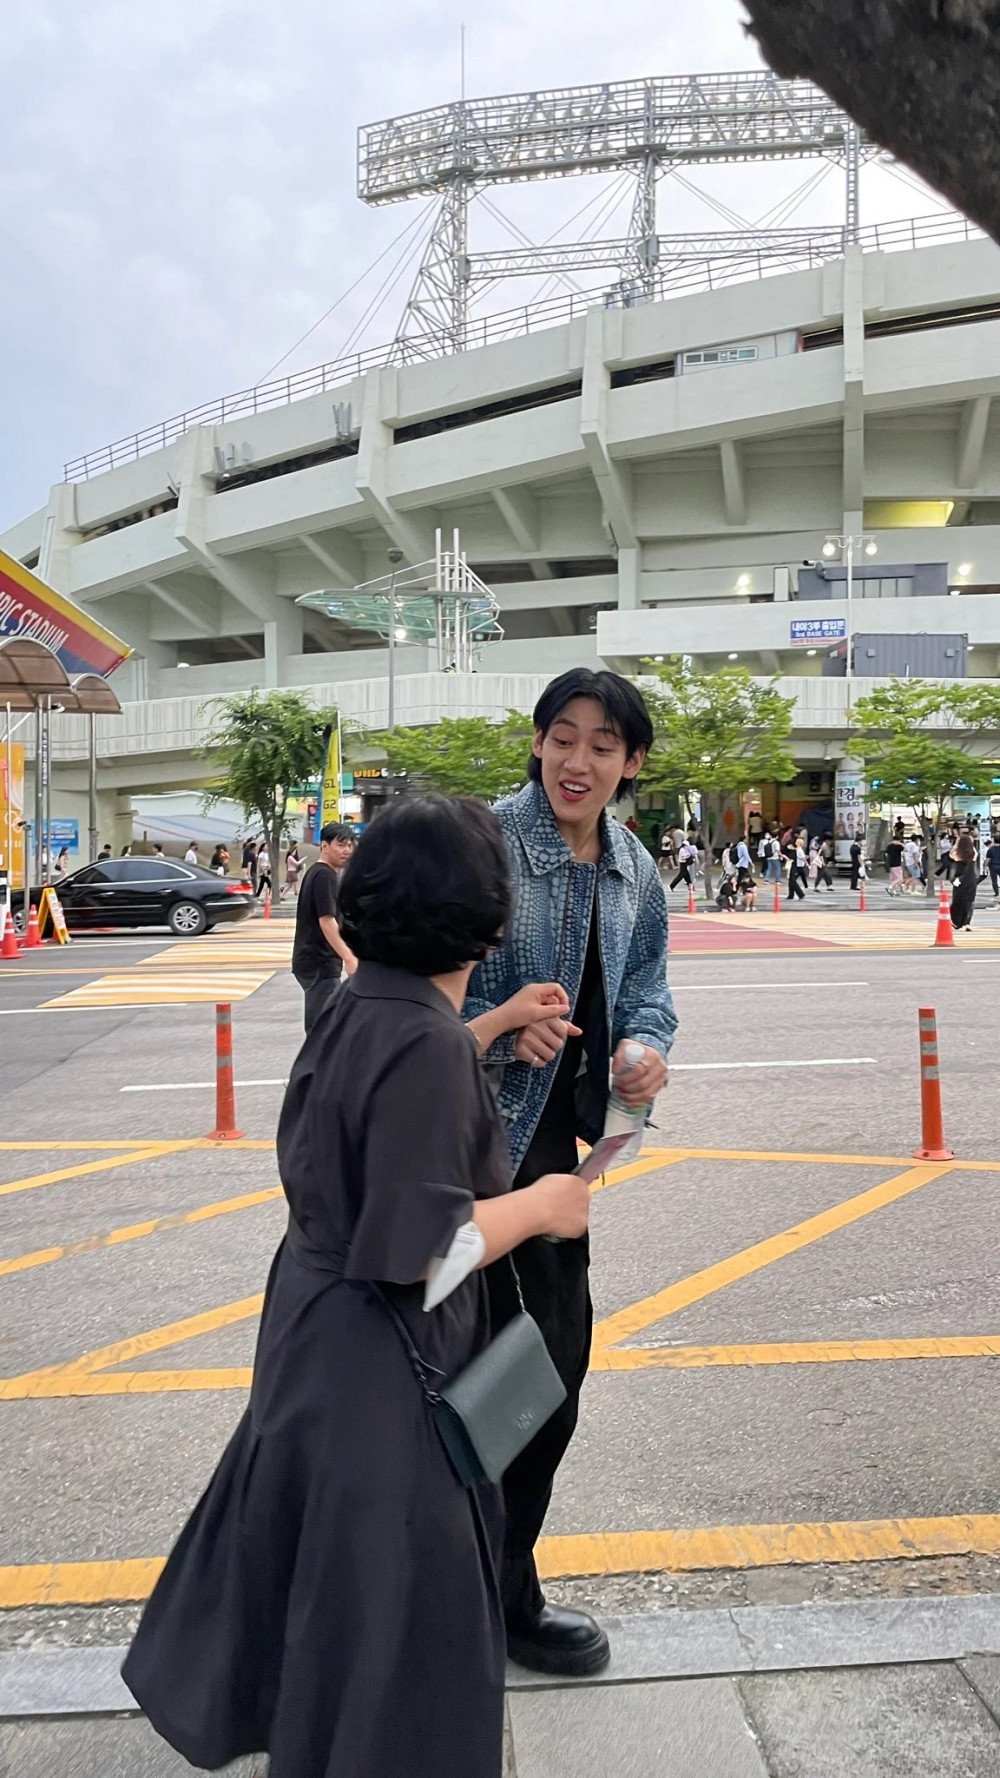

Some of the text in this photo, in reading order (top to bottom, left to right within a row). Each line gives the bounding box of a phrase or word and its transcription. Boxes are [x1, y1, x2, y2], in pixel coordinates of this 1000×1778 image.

[9, 609, 70, 655] STADIUM
[324, 778, 336, 789] G1
[323, 799, 337, 810] G2
